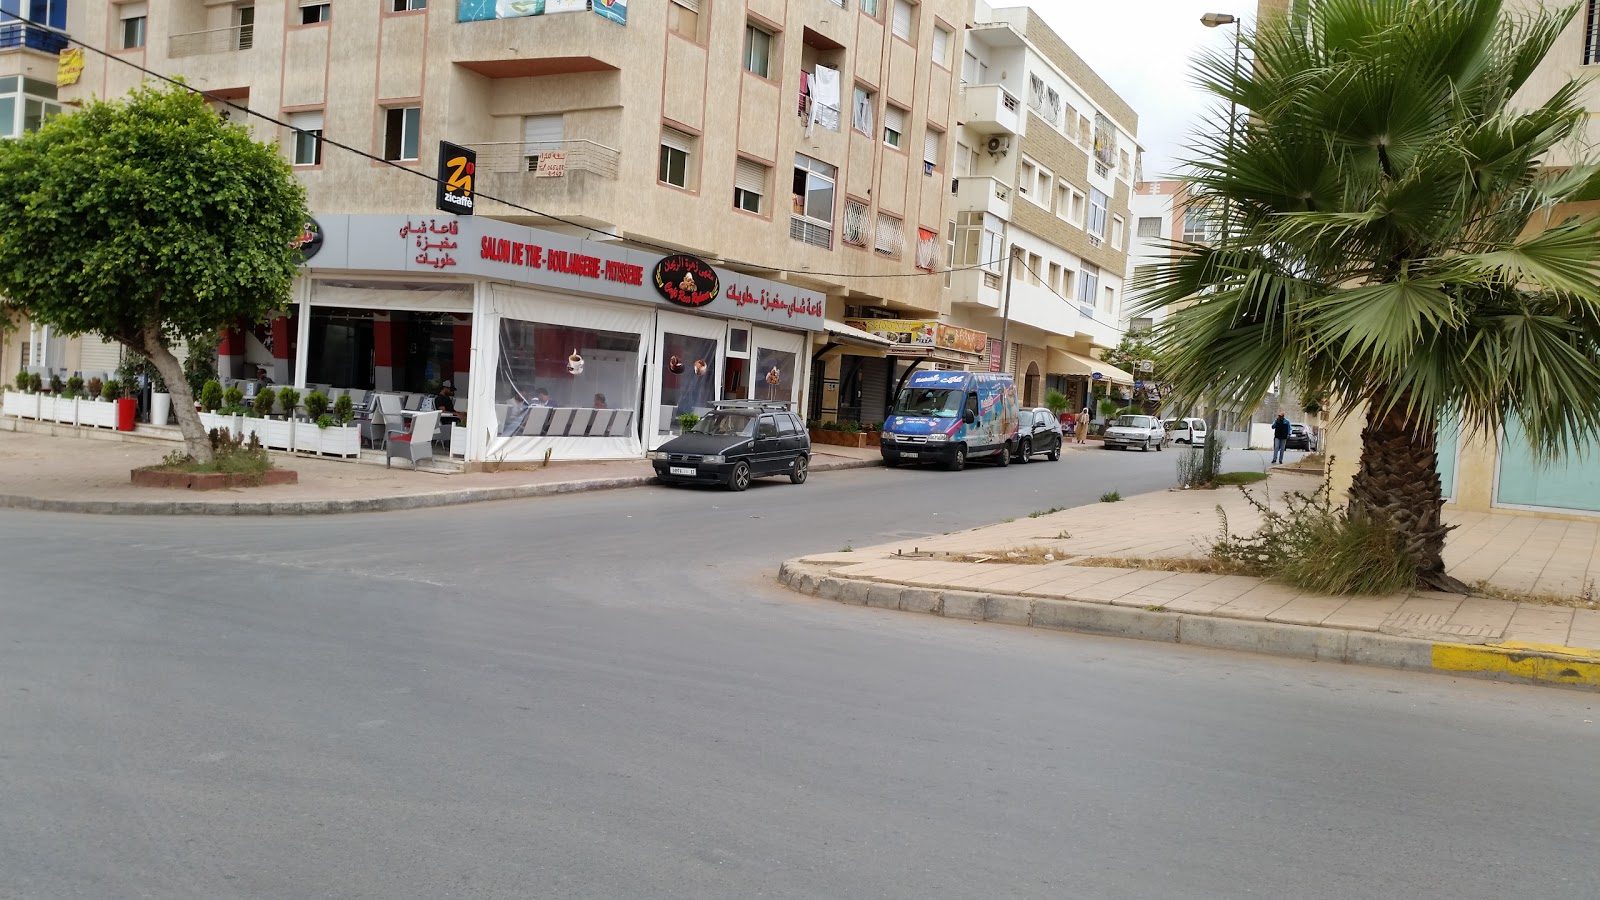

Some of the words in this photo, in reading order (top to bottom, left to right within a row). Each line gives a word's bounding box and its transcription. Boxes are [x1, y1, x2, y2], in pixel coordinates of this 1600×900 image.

[444, 192, 473, 208] zicaffè
[400, 221, 427, 239] شاي
[429, 219, 458, 235] قاعة
[416, 235, 457, 251] مخبزة
[415, 252, 457, 269] حلويات
[480, 235, 511, 264] SALON
[511, 241, 525, 266] DE
[525, 244, 543, 269] THE
[547, 248, 602, 279] BOULANGERIE
[605, 259, 644, 286] PATISSERIE
[726, 283, 754, 307] حلويات
[760, 288, 784, 312] مخبزة
[787, 296, 806, 319] شاي
[806, 297, 822, 318] قاعة
